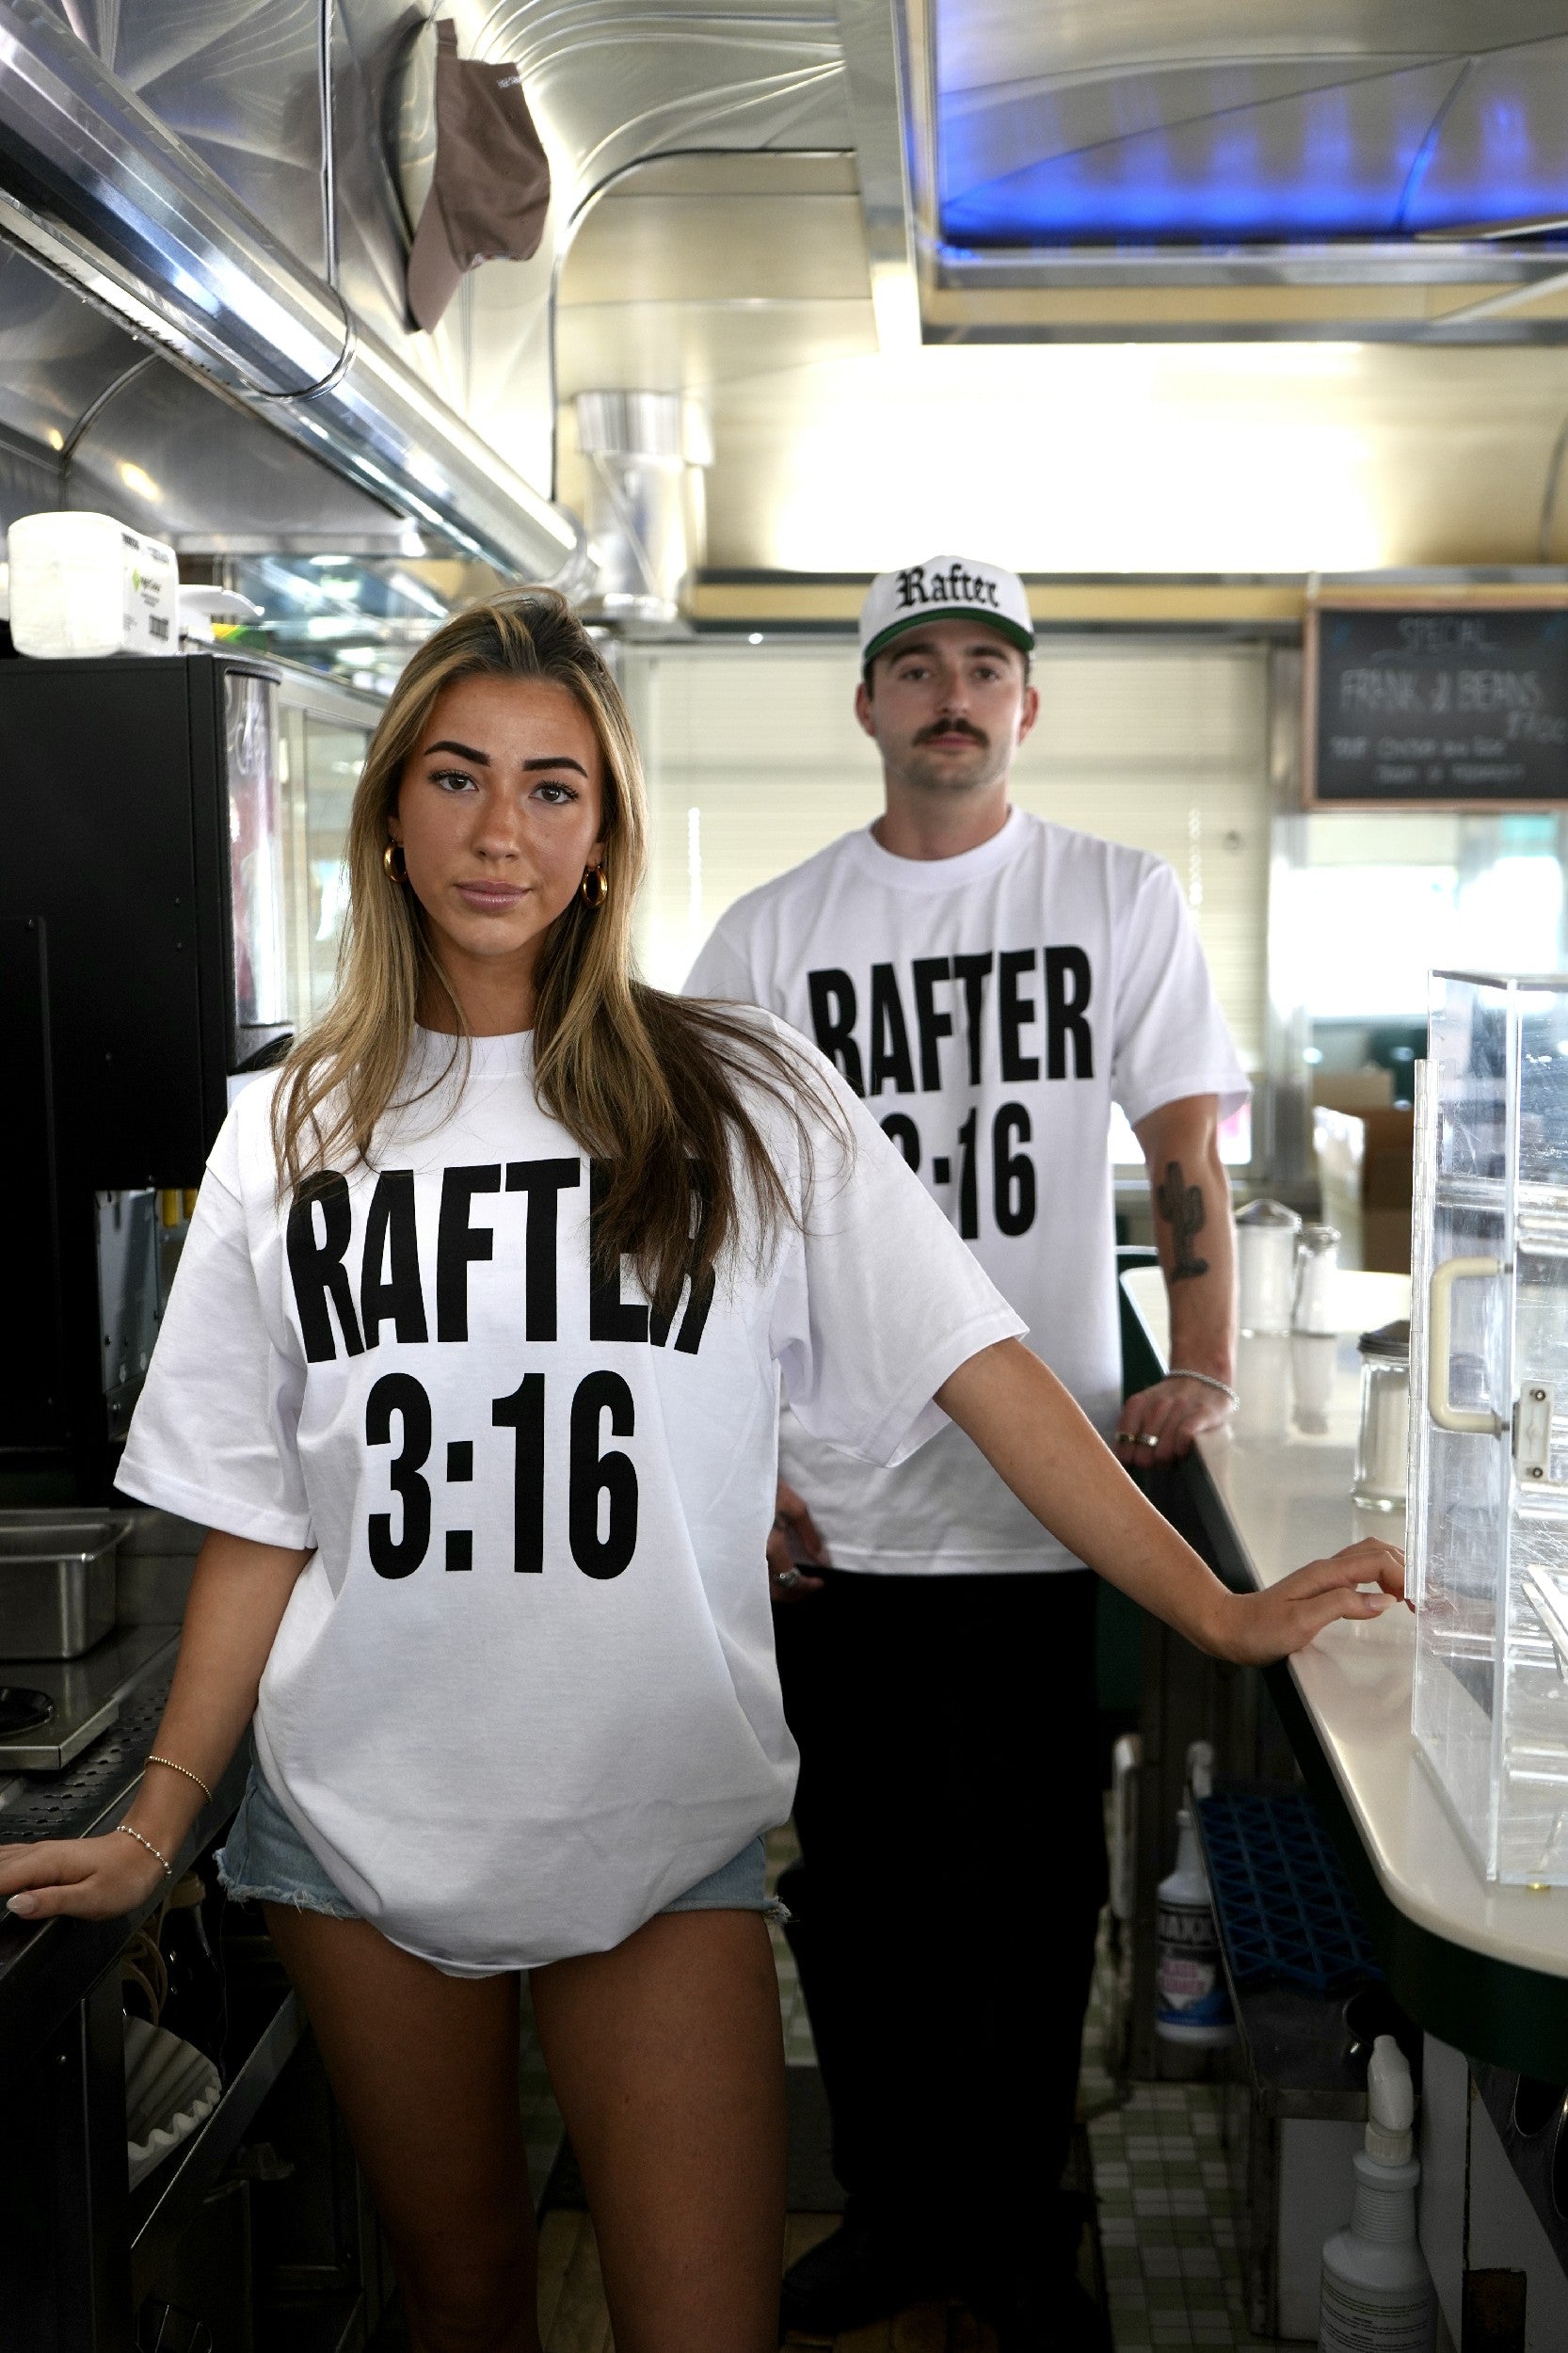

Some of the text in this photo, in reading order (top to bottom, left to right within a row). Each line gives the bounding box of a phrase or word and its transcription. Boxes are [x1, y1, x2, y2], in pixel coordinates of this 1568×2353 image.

[896, 563, 1000, 609] Rafter
[807, 945, 1094, 1098] RAFTER
[286, 1157, 716, 1363] RAFTER
[365, 1370, 639, 1580] 3:16
